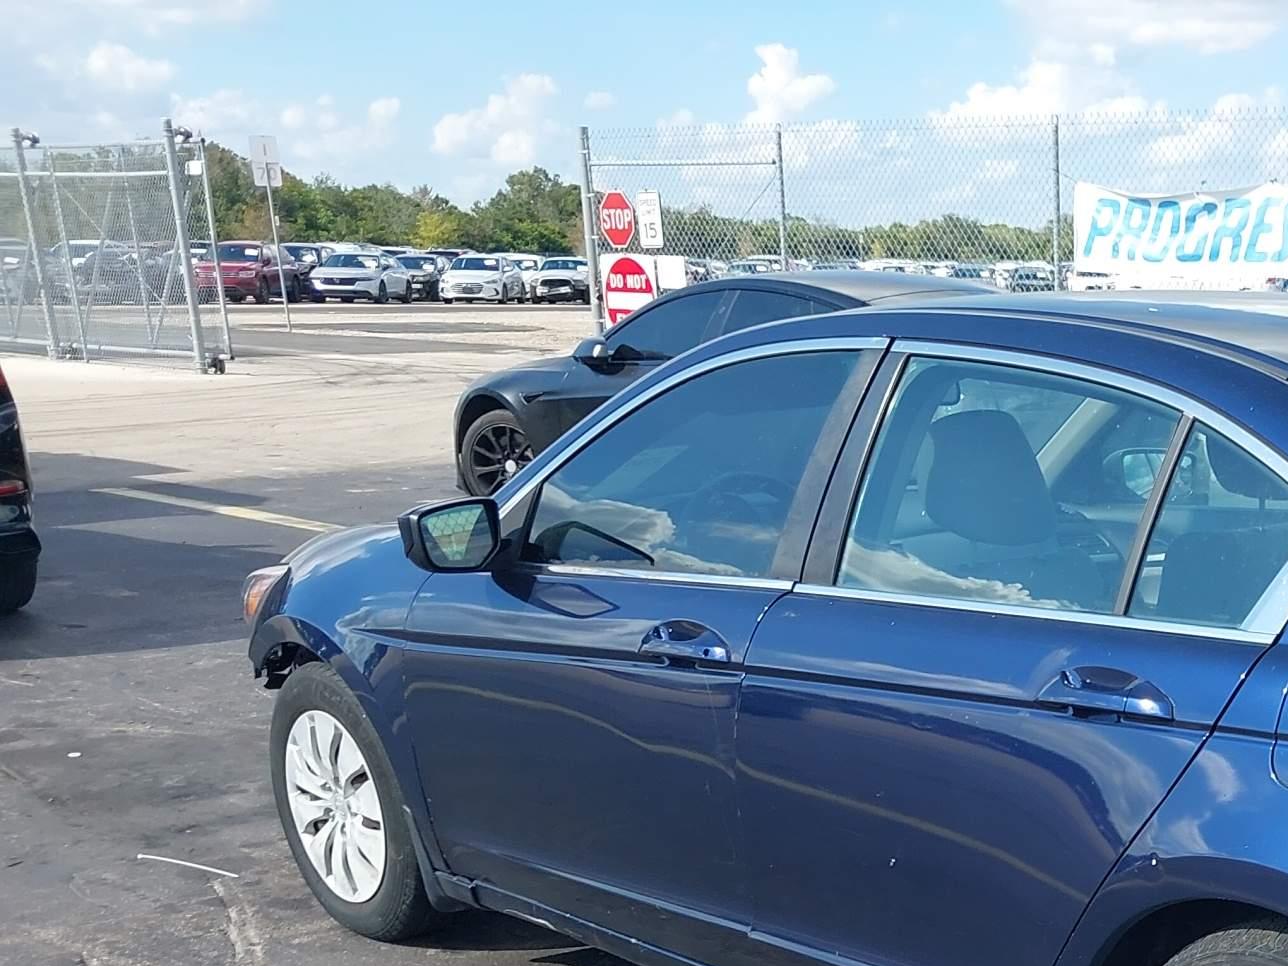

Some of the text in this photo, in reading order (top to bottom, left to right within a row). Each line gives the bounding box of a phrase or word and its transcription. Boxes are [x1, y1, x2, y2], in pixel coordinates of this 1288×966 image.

[602, 208, 632, 230] STOP
[644, 222, 657, 239] 15
[609, 273, 647, 289] DO NOT
